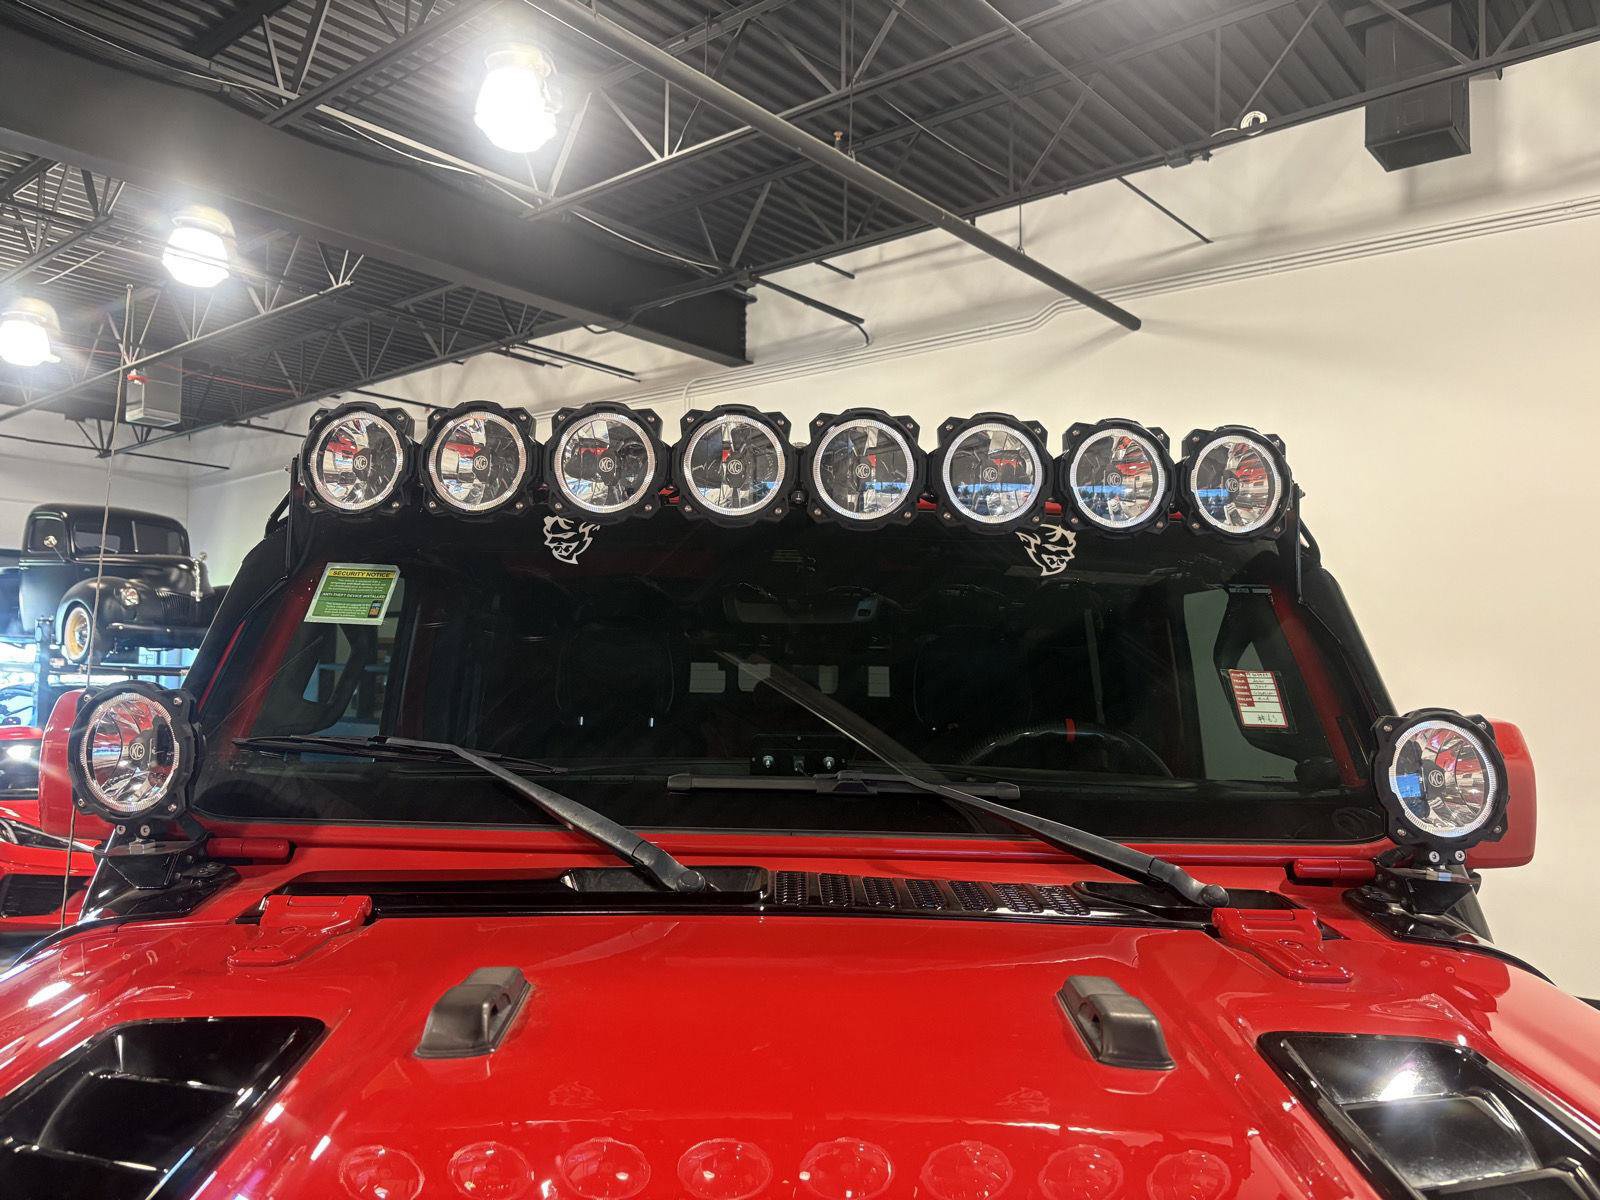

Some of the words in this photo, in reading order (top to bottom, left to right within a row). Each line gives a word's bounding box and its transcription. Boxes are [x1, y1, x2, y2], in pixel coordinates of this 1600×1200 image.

[354, 456, 366, 469] KC
[475, 457, 487, 469] KC
[600, 458, 612, 471] KC
[729, 461, 741, 473] KC
[857, 465, 869, 477] KC
[984, 468, 996, 481] KC
[1109, 474, 1121, 486] KC
[1226, 479, 1237, 491] KC
[131, 745, 143, 759] KC
[1430, 771, 1442, 785] KC
